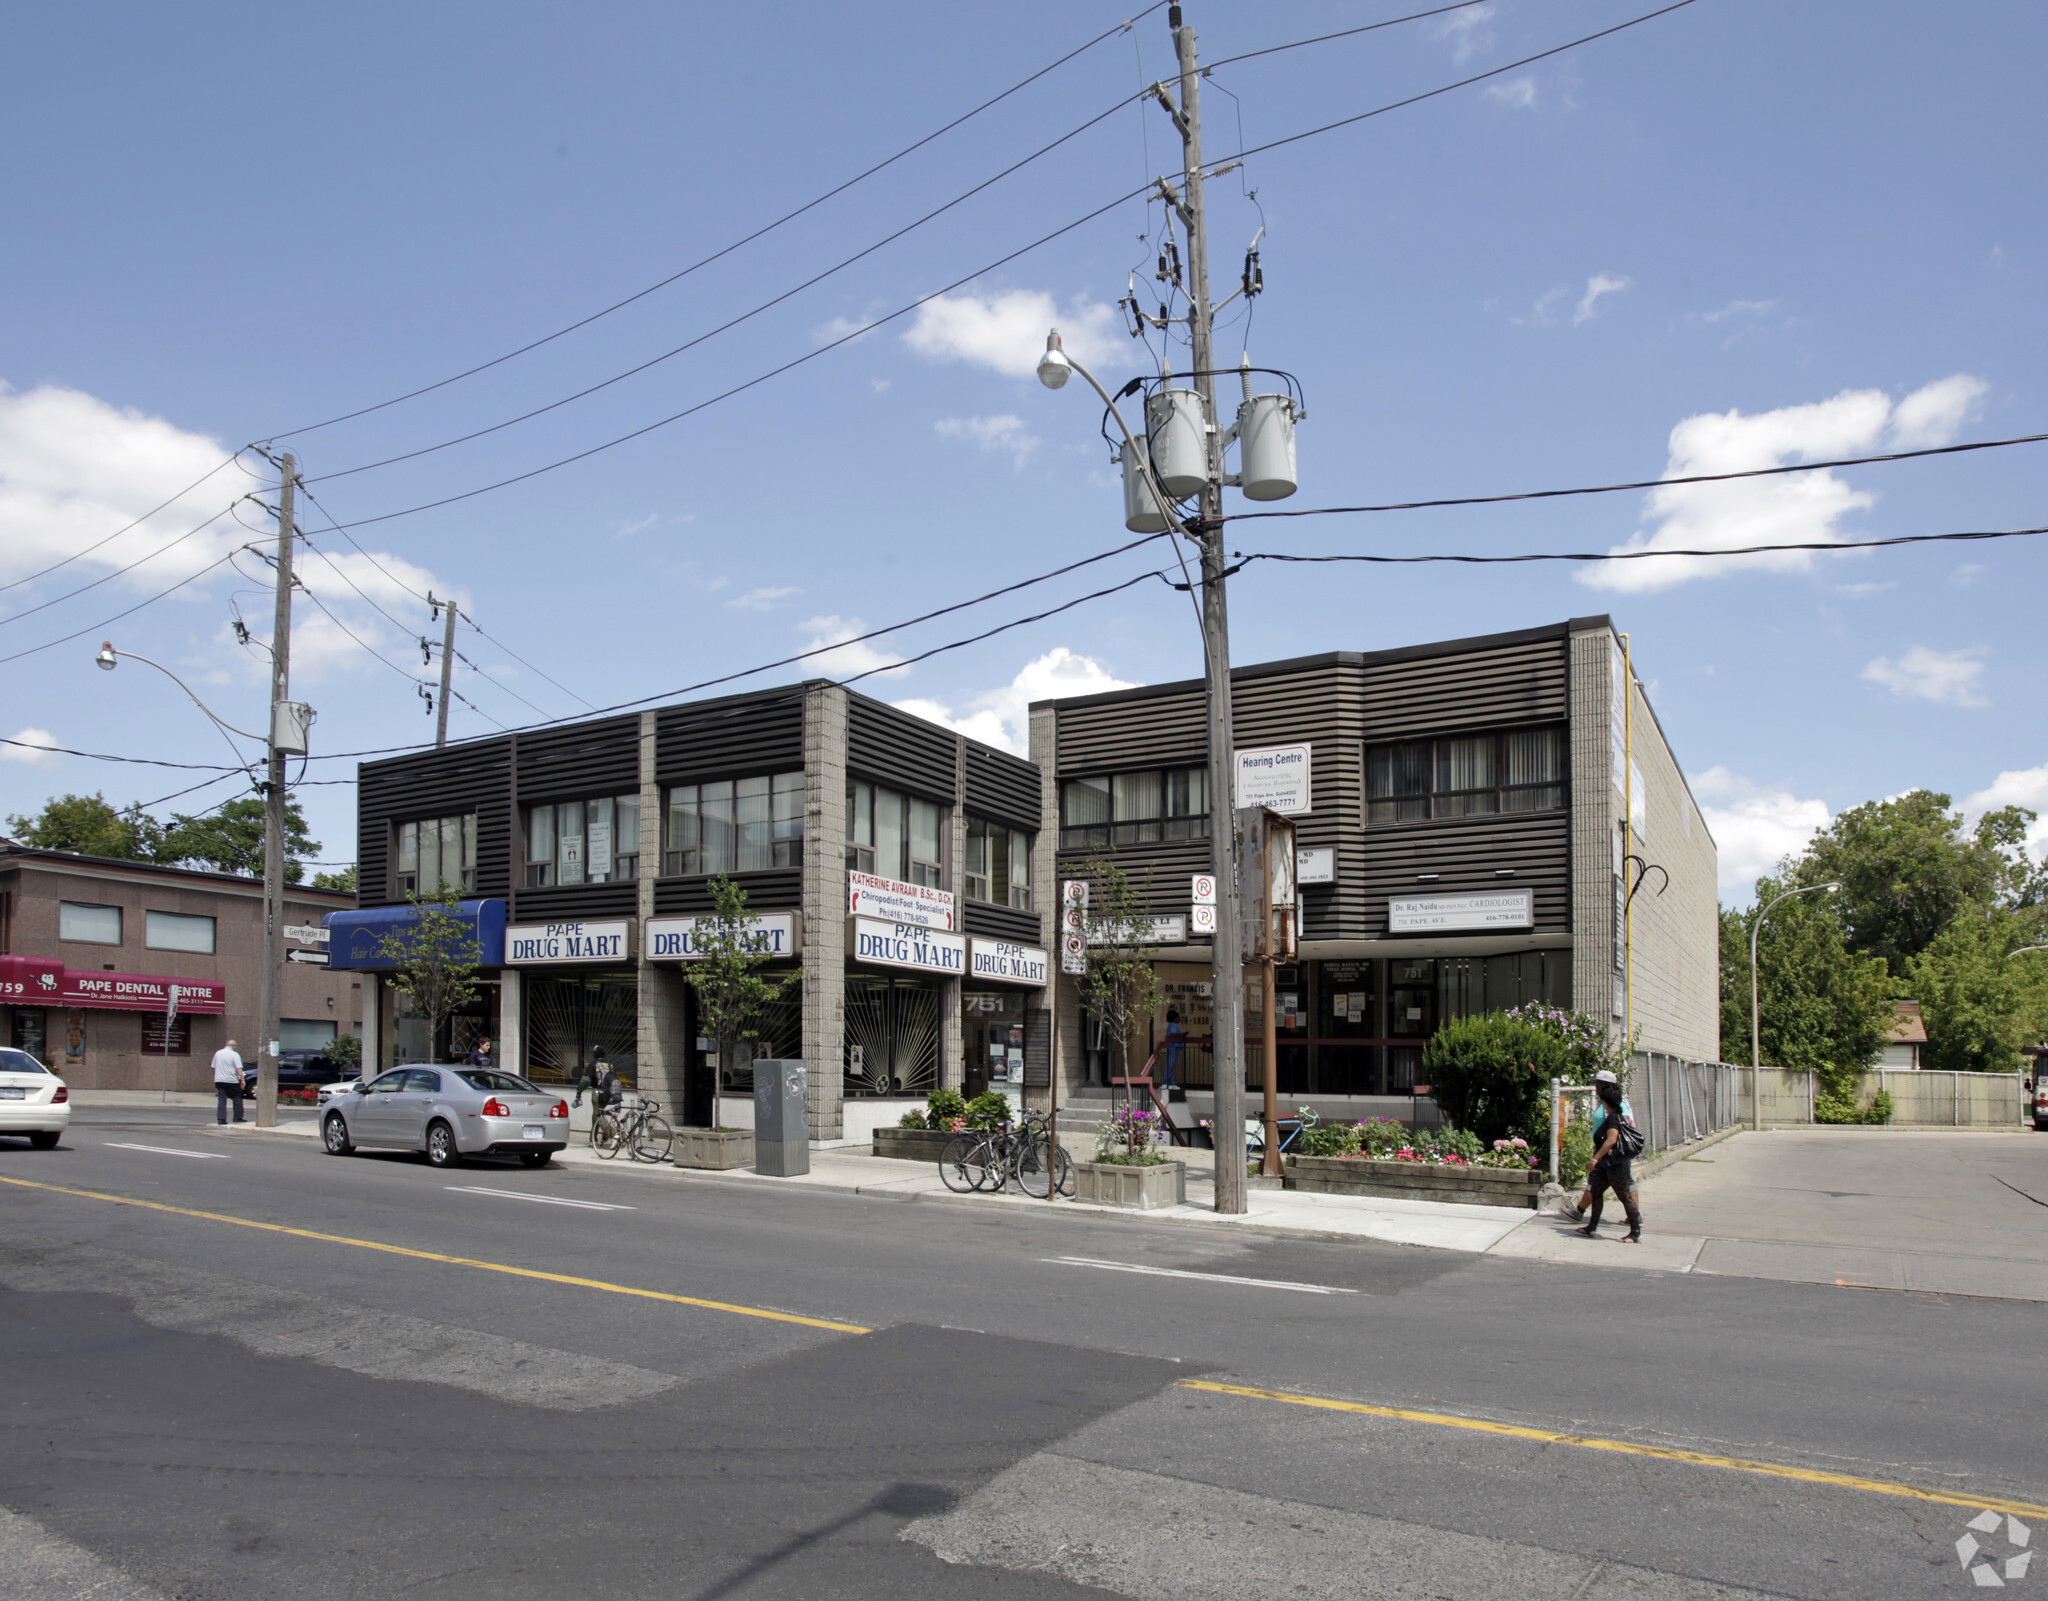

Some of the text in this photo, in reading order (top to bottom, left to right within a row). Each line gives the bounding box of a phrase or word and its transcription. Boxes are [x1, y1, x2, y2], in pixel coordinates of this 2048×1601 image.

[1242, 753, 1302, 768] Hearing Centre
[852, 872, 890, 892] KATHERINE
[891, 882, 918, 898] AVRAAM
[915, 901, 945, 916] Specialist
[1395, 904, 1404, 912] Dr.
[1406, 903, 1418, 913] Raj
[1419, 901, 1438, 911] Naidu
[1469, 898, 1525, 909] CARDIOLOGIST
[904, 911, 929, 925] 778-9526
[1160, 917, 1170, 925] LI
[1410, 918, 1428, 926] PAPE
[1486, 913, 1525, 922] 416-778-0101
[288, 928, 317, 938] Gertrude
[546, 923, 584, 937] PAPE
[895, 924, 931, 943] PAPE
[351, 946, 368, 960] Hair
[513, 935, 621, 960] DRUG MART
[859, 933, 963, 969] DRUG MART
[996, 942, 1026, 959] PAPE
[974, 952, 1045, 981] DRUG MART
[1403, 967, 1422, 979] 751
[80, 980, 112, 992] PAPE
[115, 983, 164, 996] DENTAL
[1178, 984, 1205, 993] FRANCIS
[964, 997, 1004, 1013] 751
[1180, 1015, 1209, 1025] 78-1810
